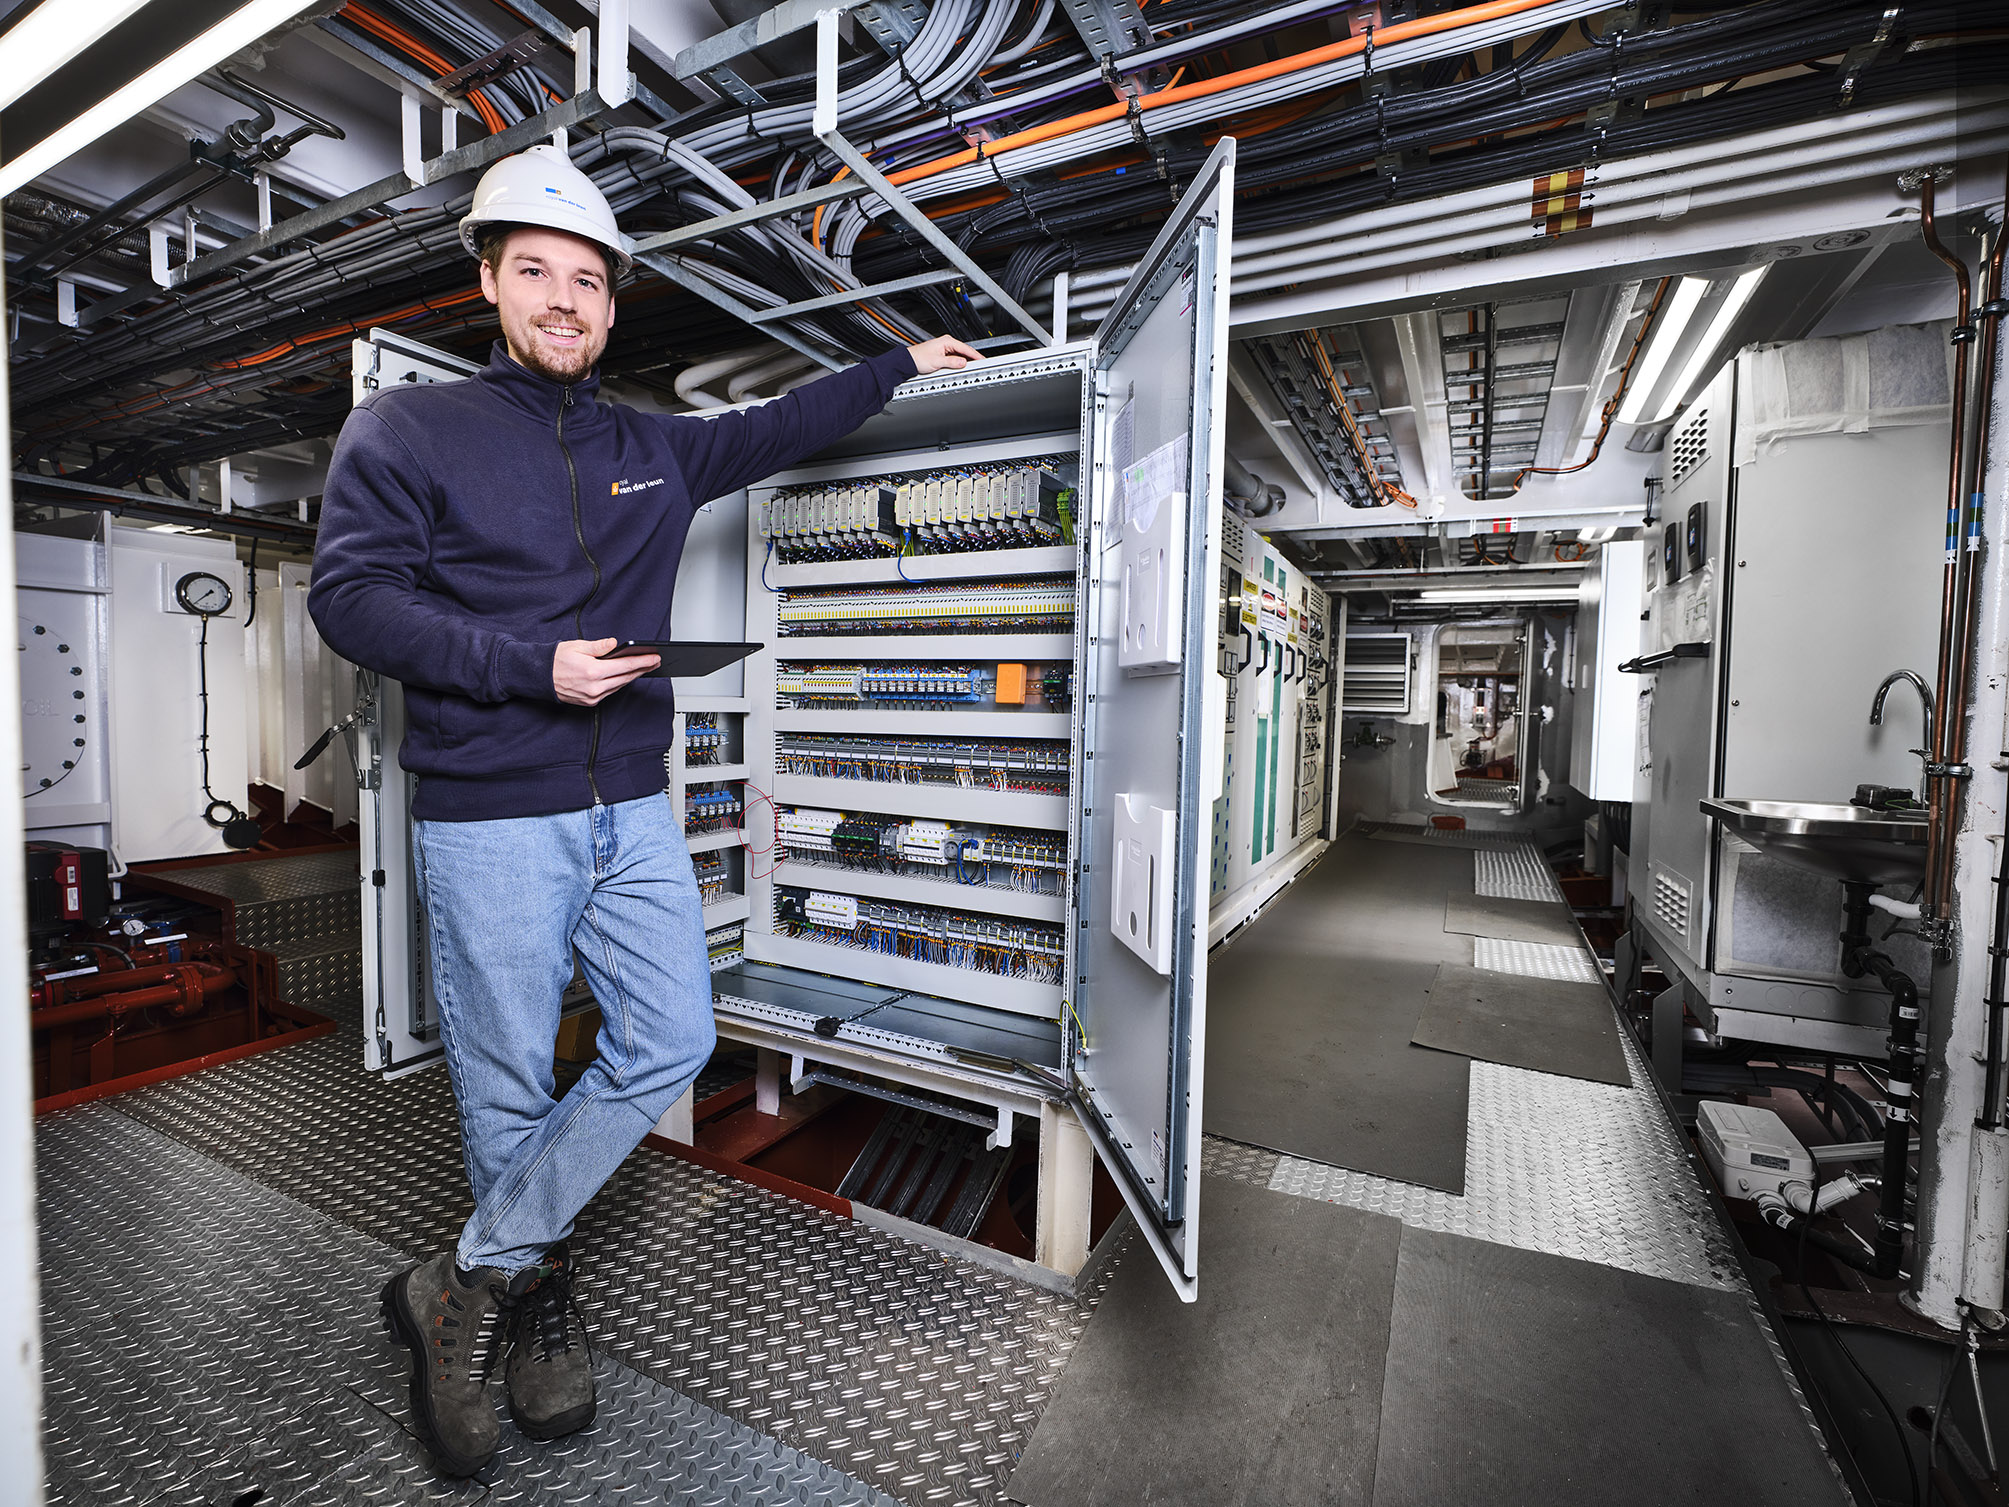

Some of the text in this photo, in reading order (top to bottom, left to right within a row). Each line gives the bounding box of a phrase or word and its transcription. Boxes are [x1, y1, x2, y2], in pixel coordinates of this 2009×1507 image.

[618, 478, 665, 495] van der leun
